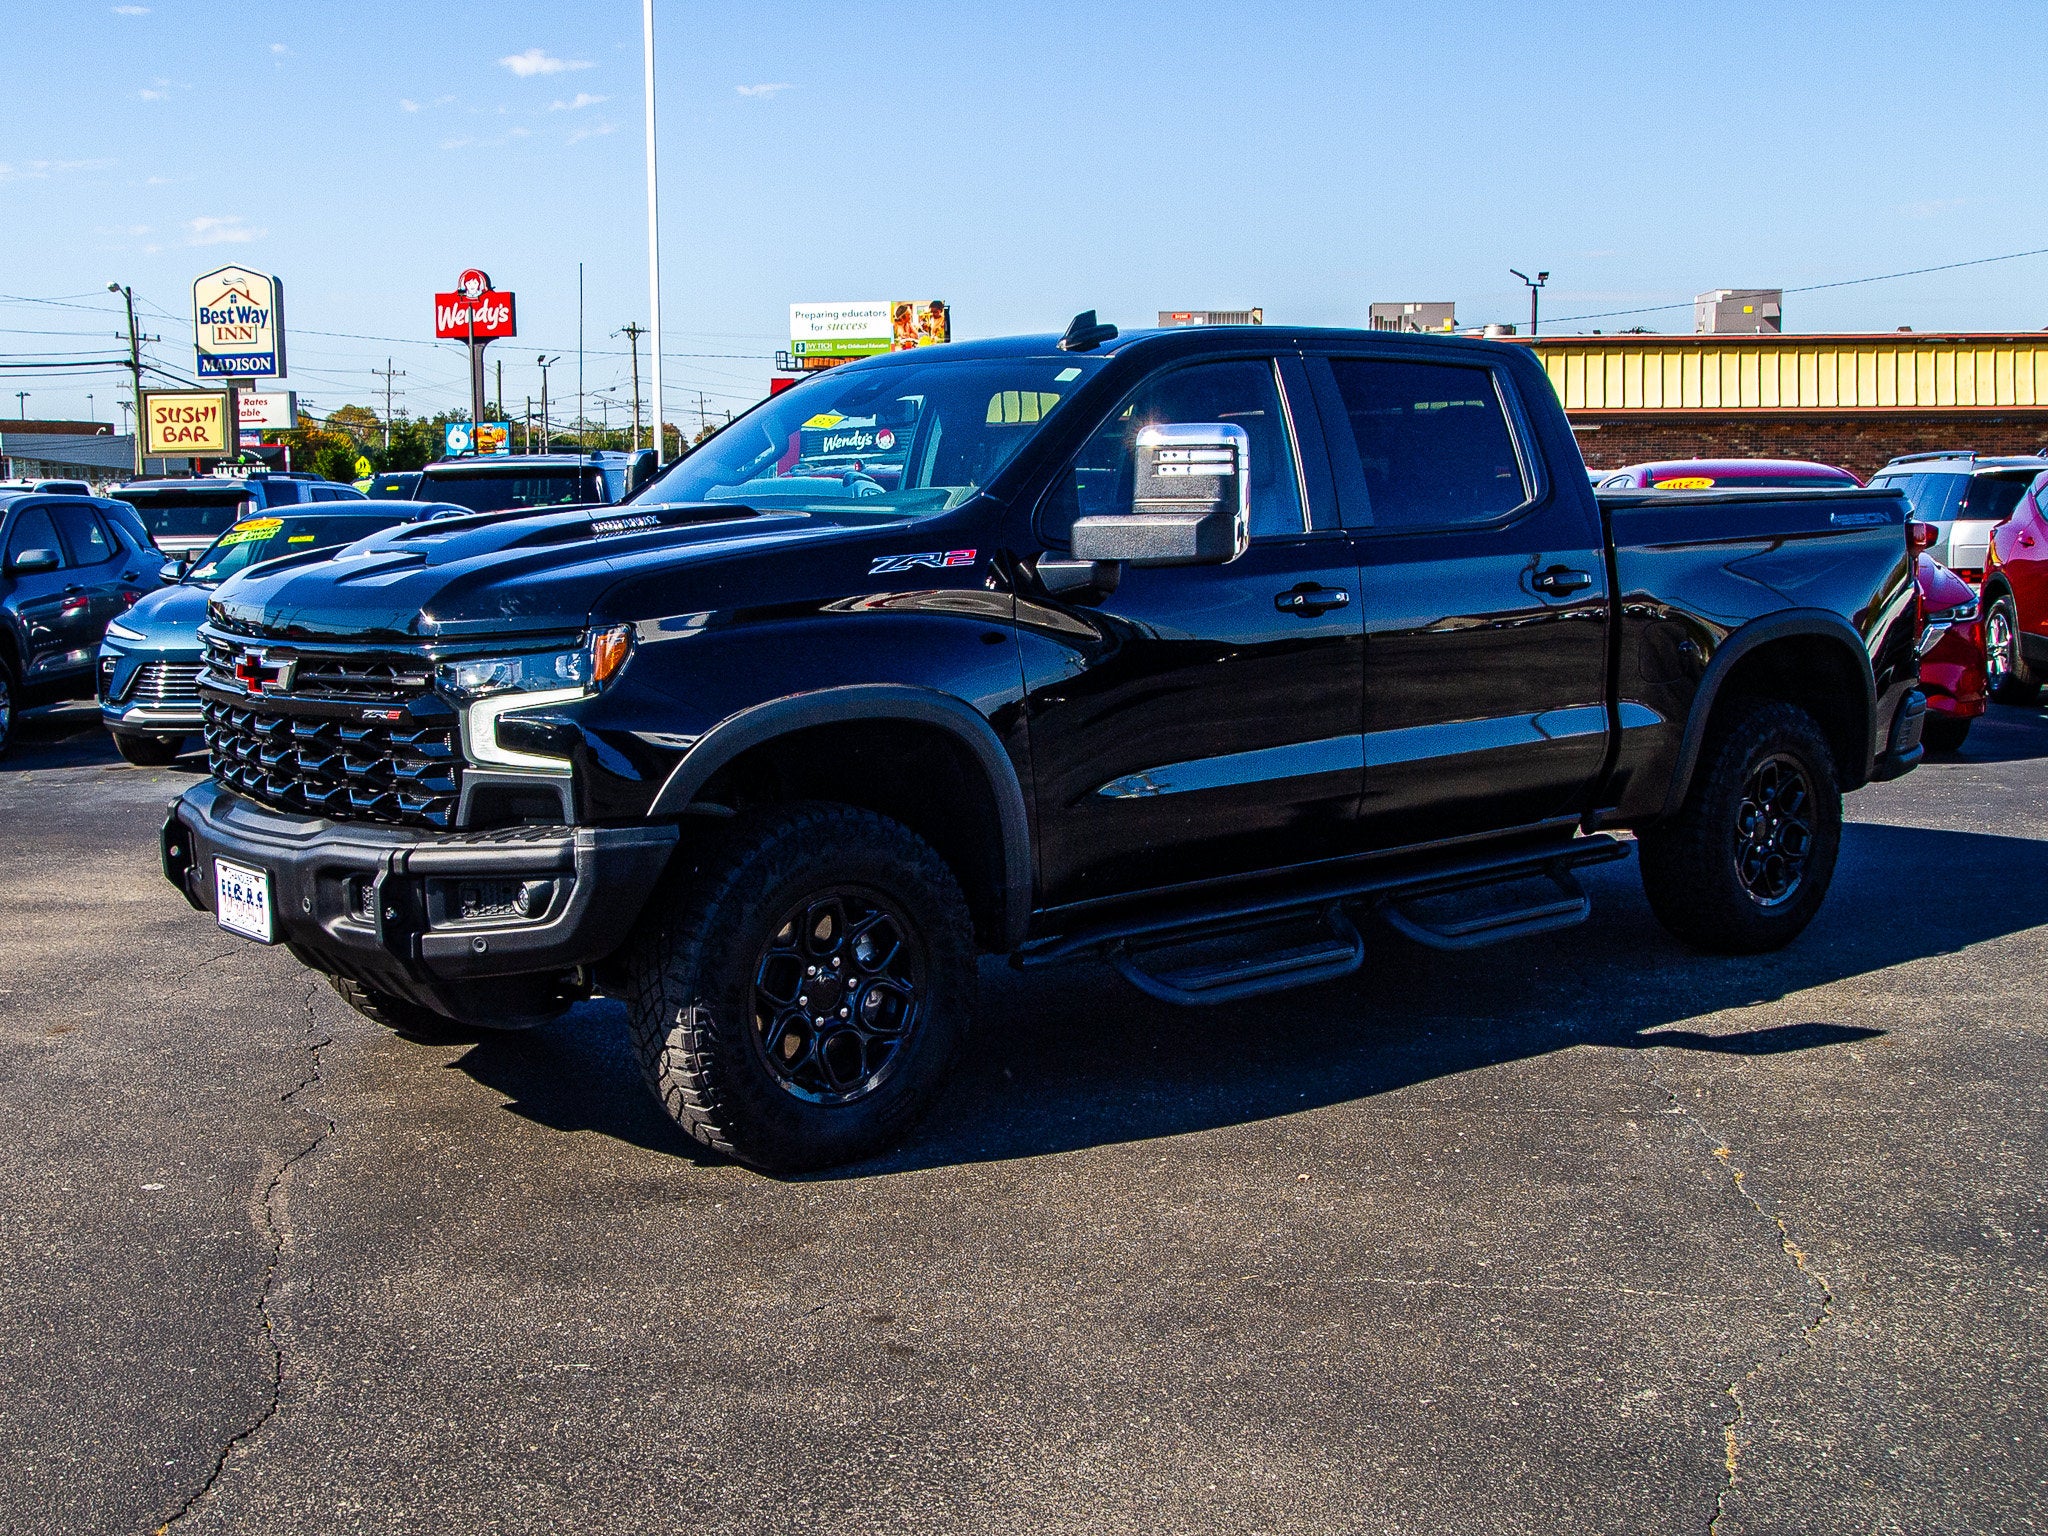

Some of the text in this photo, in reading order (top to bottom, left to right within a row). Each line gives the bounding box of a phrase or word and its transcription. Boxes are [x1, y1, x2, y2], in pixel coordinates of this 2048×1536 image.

[199, 306, 269, 329] Best Way
[437, 298, 509, 332] Wendy's
[795, 309, 887, 321] Preparing educators
[217, 326, 253, 341] INN
[811, 321, 869, 331] for success
[202, 356, 272, 373] MADISON
[243, 398, 268, 406] Rates
[155, 406, 217, 424] SUSHI
[239, 408, 261, 417] able
[163, 426, 210, 443] BAR
[822, 429, 873, 453] Wendy's
[867, 549, 978, 575] ZR2
